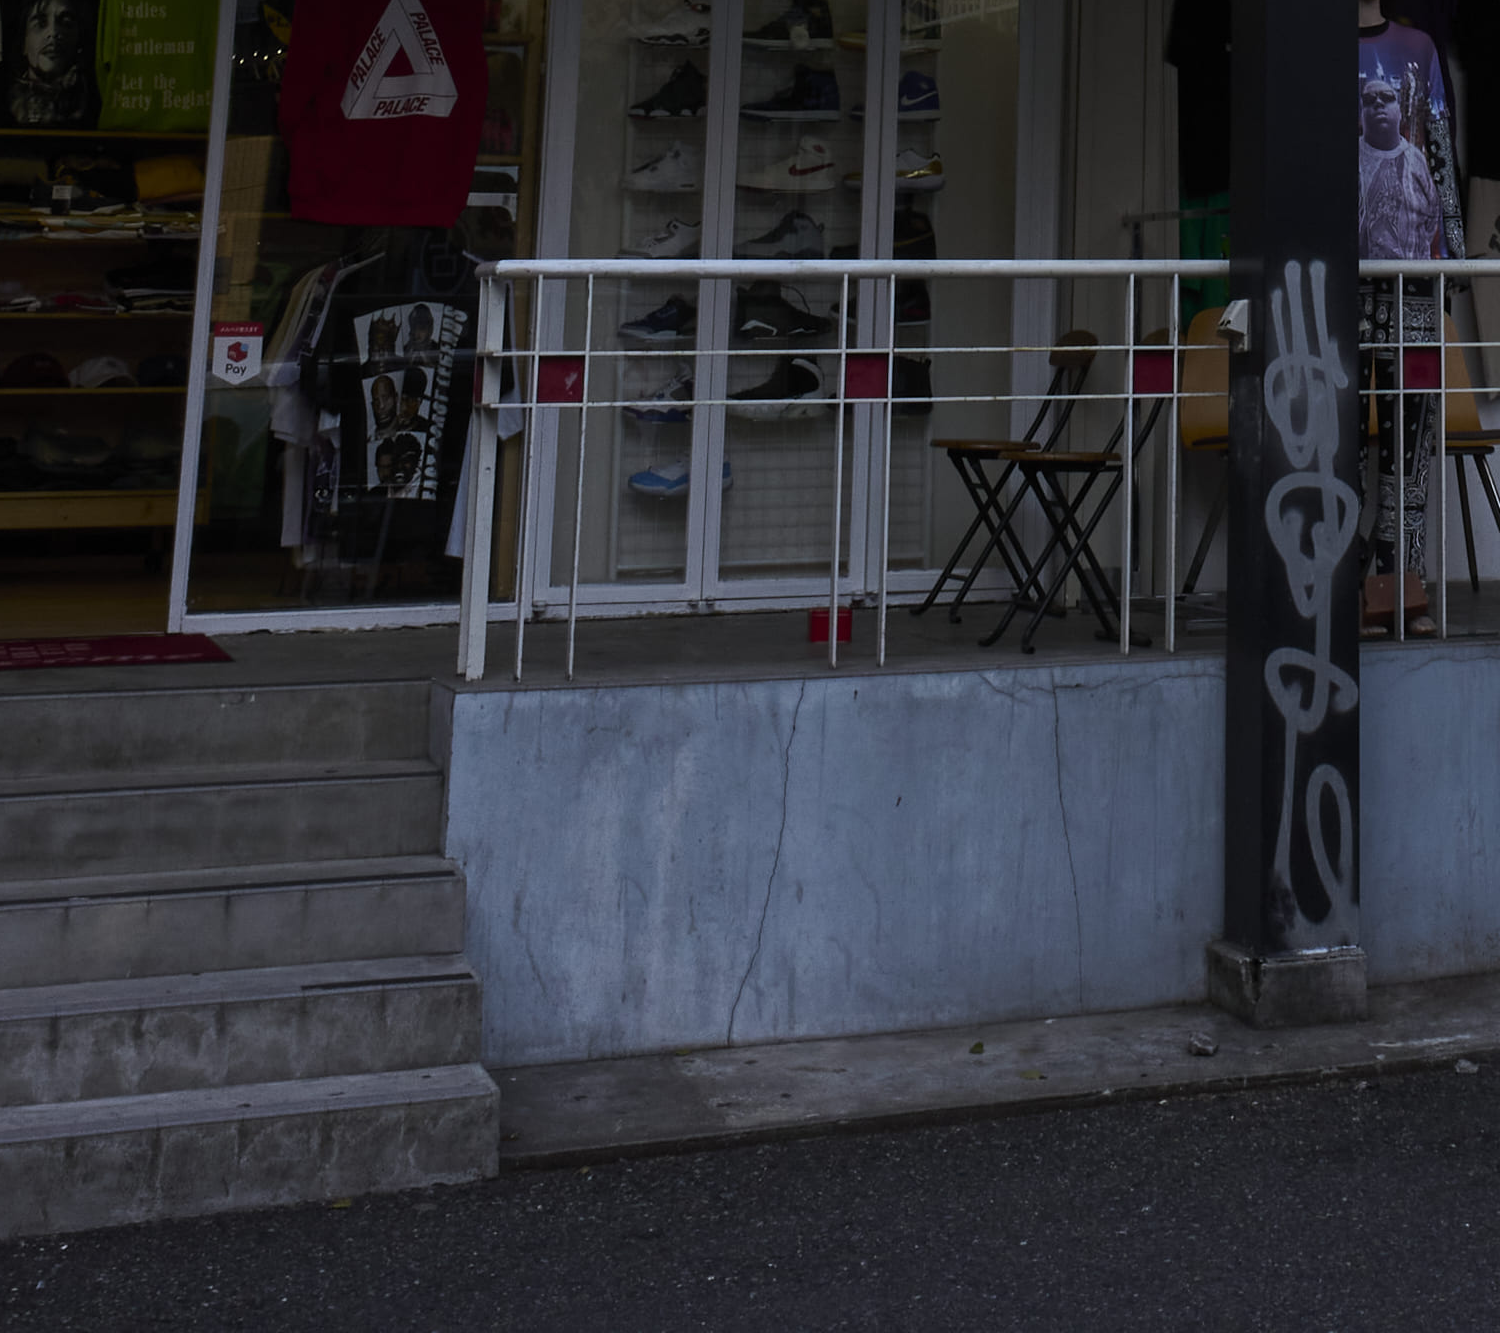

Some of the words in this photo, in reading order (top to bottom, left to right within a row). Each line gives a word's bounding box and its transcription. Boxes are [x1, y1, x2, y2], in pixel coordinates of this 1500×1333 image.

[408, 11, 445, 66] PALACE
[350, 27, 386, 91] PALACE
[372, 97, 431, 116] PALACE
[225, 363, 247, 376] Pay
